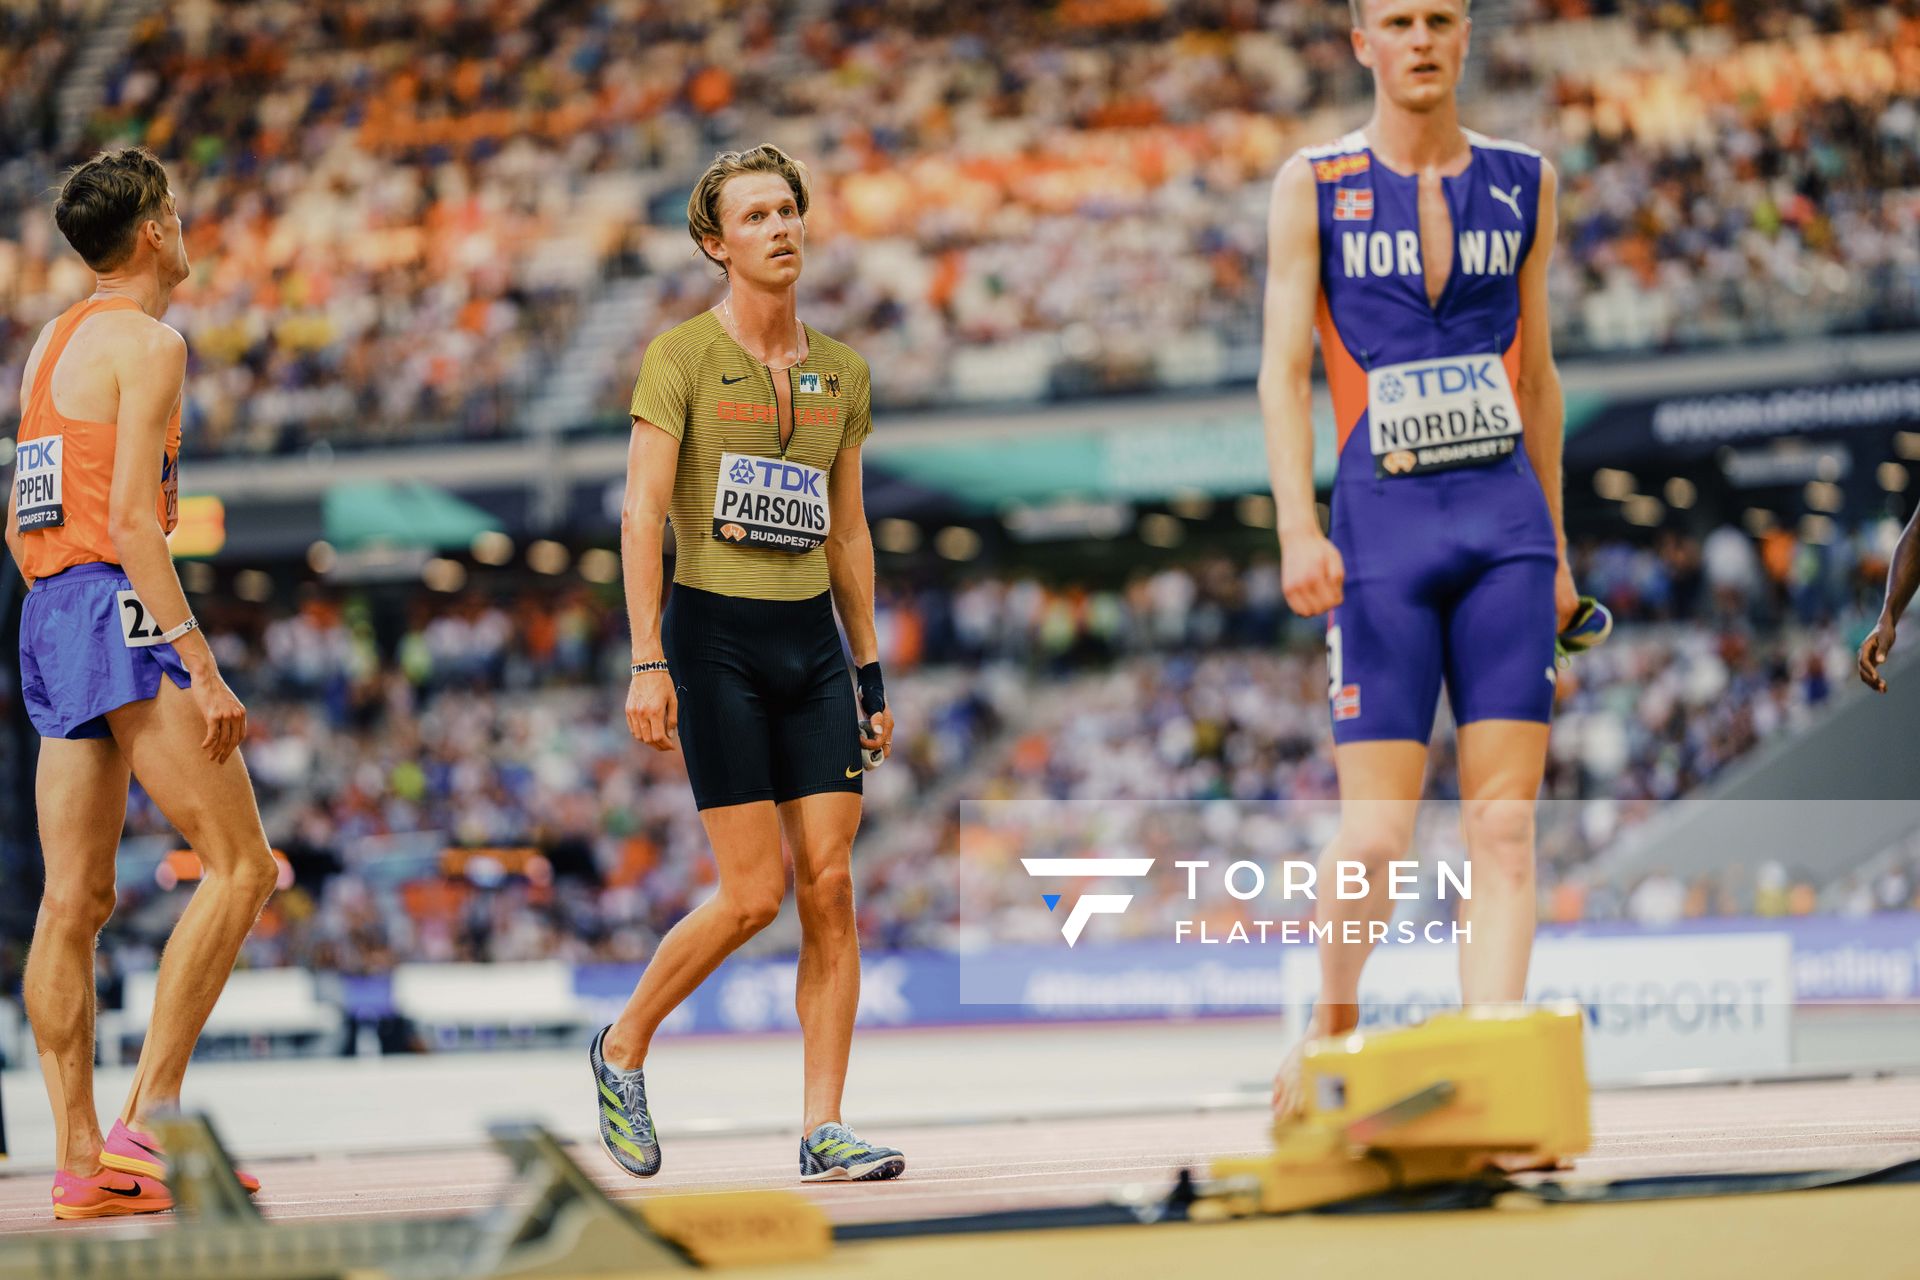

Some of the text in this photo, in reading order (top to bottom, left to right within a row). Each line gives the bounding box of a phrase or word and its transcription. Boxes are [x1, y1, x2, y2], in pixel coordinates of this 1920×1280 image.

[1404, 362, 1497, 397] TDK
[1379, 400, 1510, 447] NORDÅS
[17, 440, 56, 471] TDK
[17, 474, 54, 507] PPEN
[755, 461, 821, 498] TDK
[19, 510, 57, 526] UDAPEST 23
[721, 490, 826, 530] PARSONS
[750, 529, 811, 548] BUDAPEST
[124, 599, 163, 638] 2
